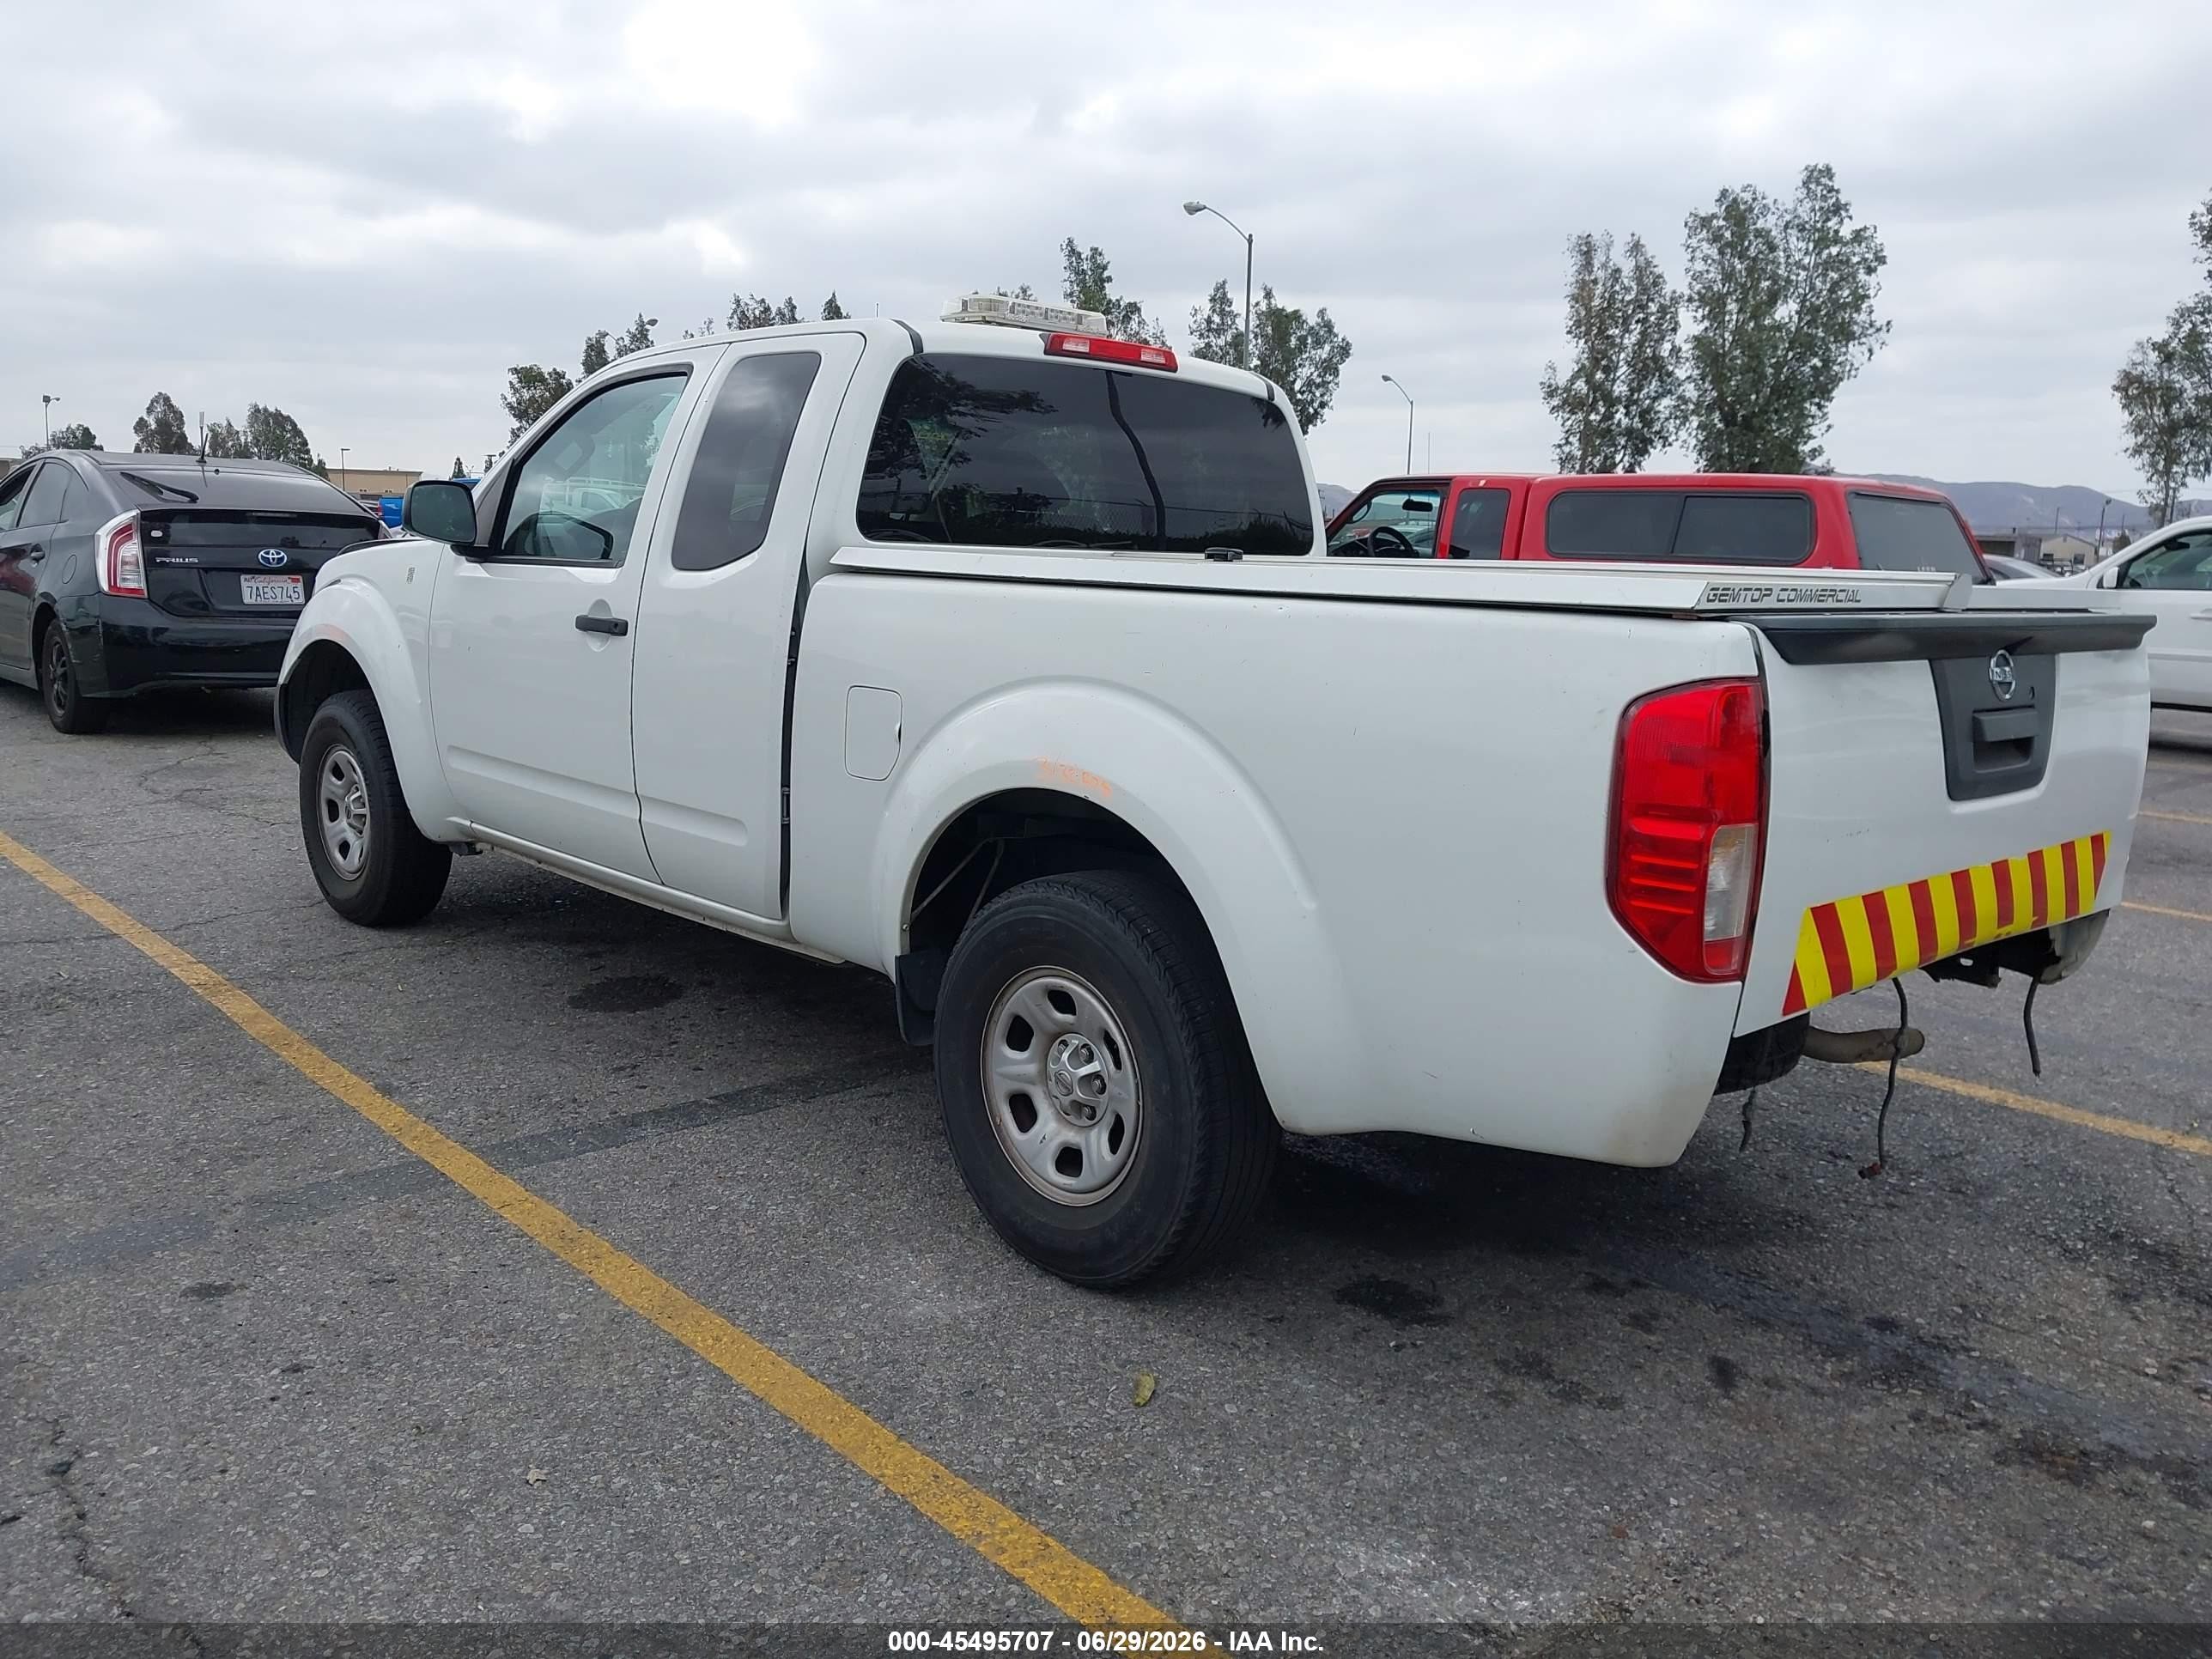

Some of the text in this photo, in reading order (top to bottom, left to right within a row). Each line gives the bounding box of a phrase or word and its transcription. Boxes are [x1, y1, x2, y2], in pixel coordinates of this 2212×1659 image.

[254, 576, 288, 585] California
[246, 586, 301, 600] 7AES745
[1706, 587, 1862, 603] GEMTOP COMMERCIAL
